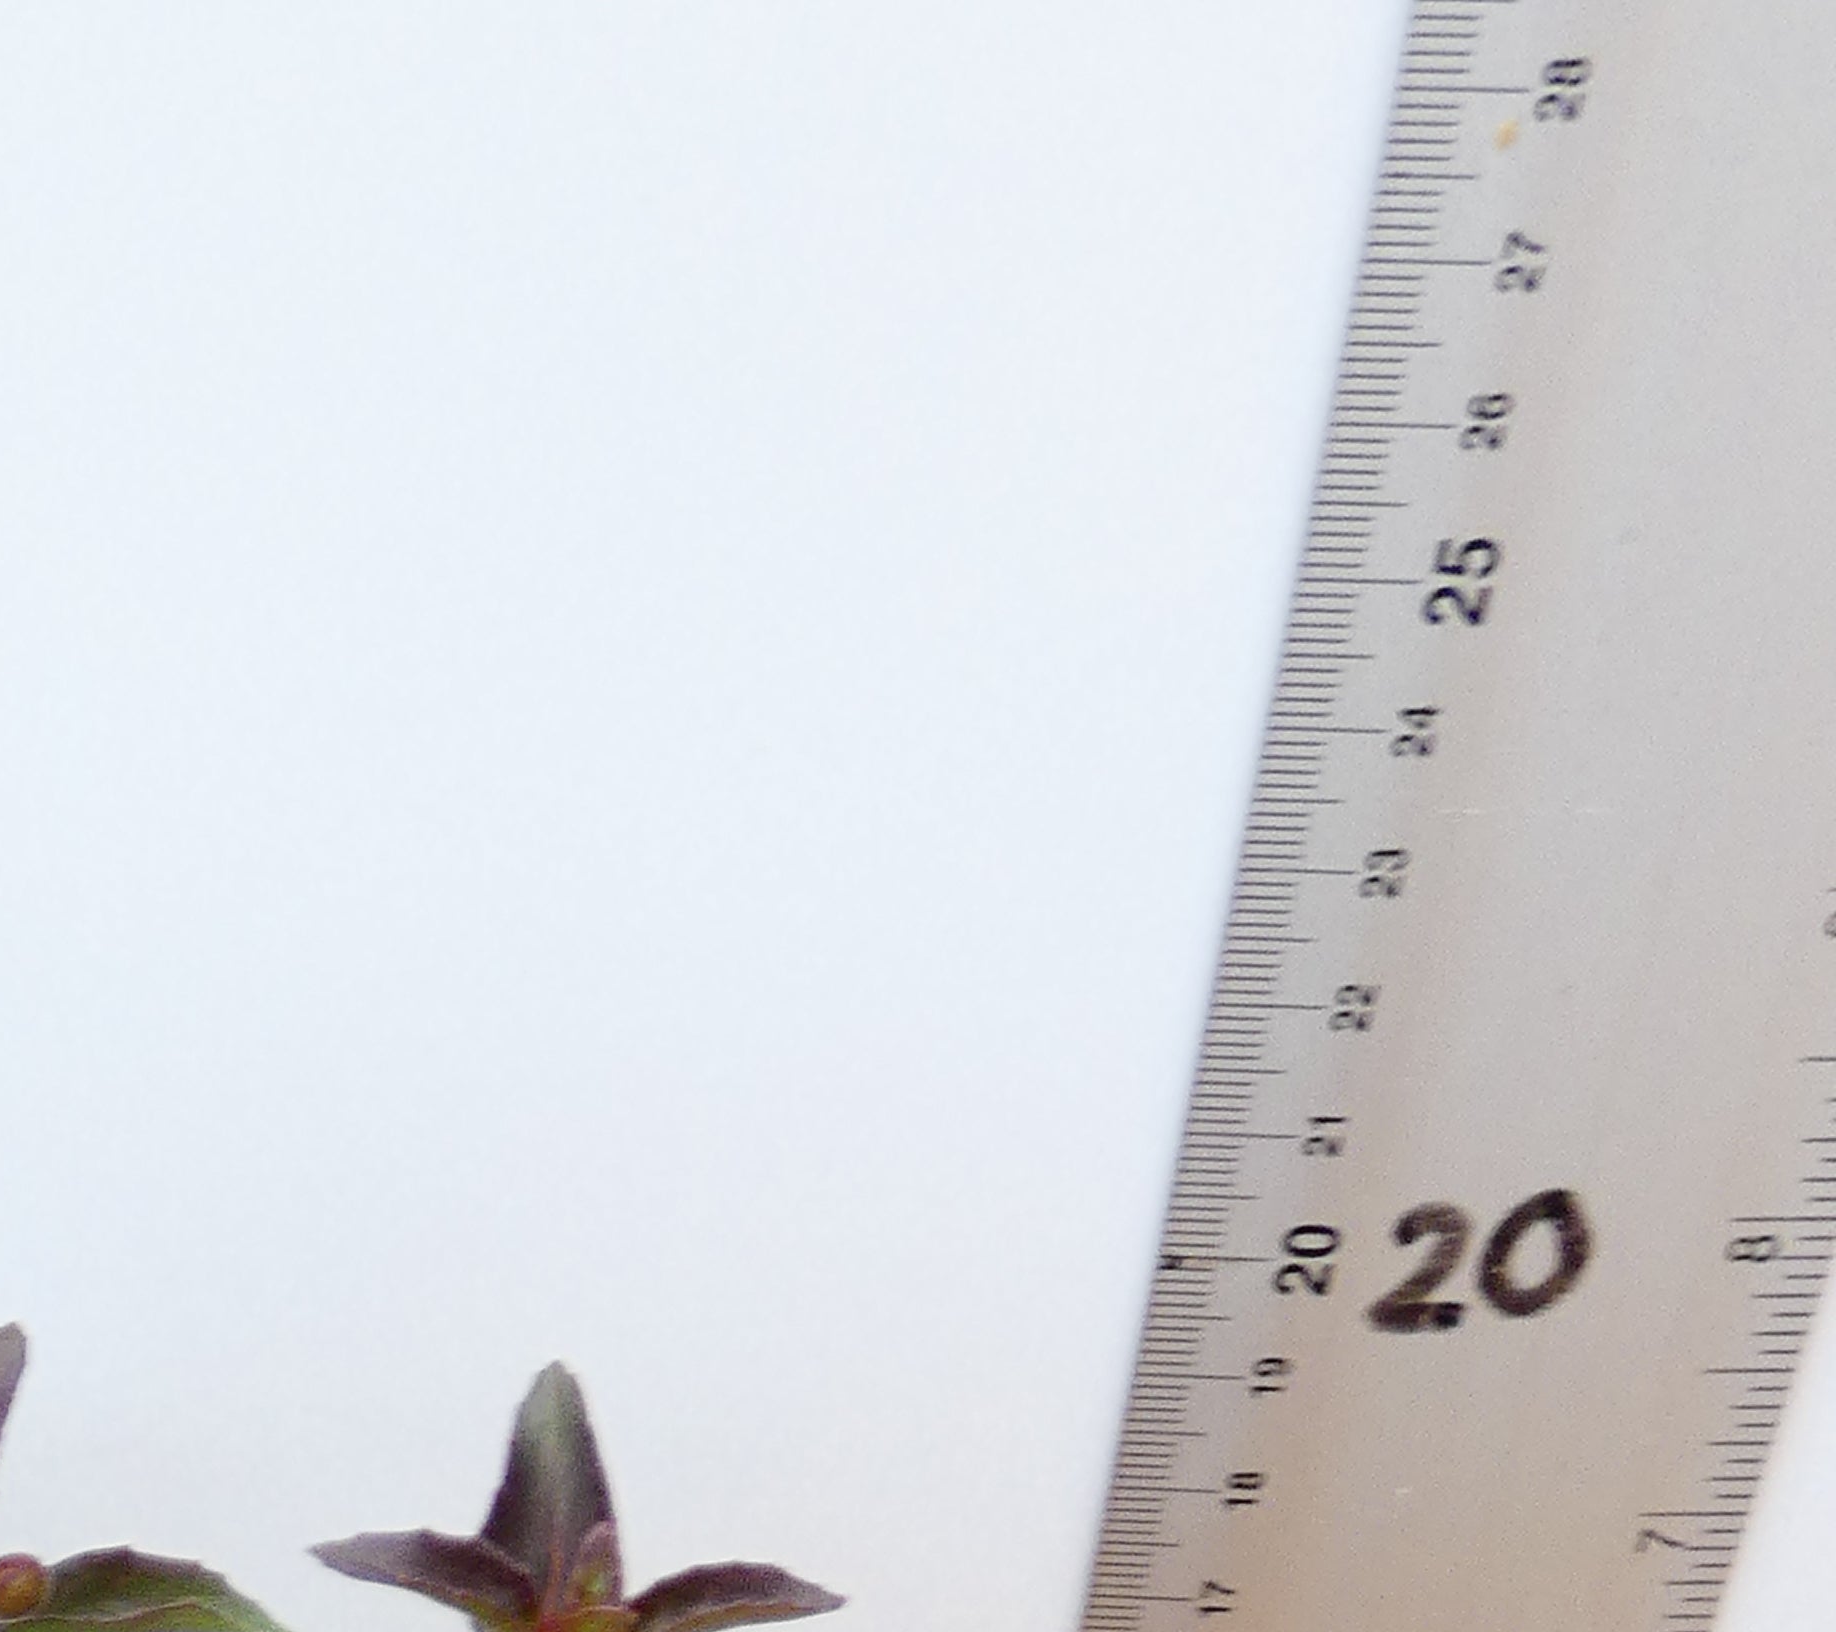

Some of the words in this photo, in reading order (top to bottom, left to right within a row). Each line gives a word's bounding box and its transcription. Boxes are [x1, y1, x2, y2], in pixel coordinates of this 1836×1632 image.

[1535, 58, 1590, 123] 28
[1495, 232, 1548, 295] 27
[1462, 394, 1513, 452] 26
[1423, 538, 1502, 628] 25
[1394, 707, 1441, 758] 24
[1362, 849, 1408, 900] 23
[1329, 985, 1378, 1033] 22
[1304, 1117, 1348, 1158] 21
[1271, 1225, 1342, 1298] 20
[1367, 1188, 1594, 1333] 20
[1725, 1234, 1780, 1264] 8
[1251, 1358, 1289, 1395] 19
[1223, 1473, 1265, 1507] 18
[1636, 1529, 1684, 1553] 7
[1198, 1581, 1237, 1616] 17
